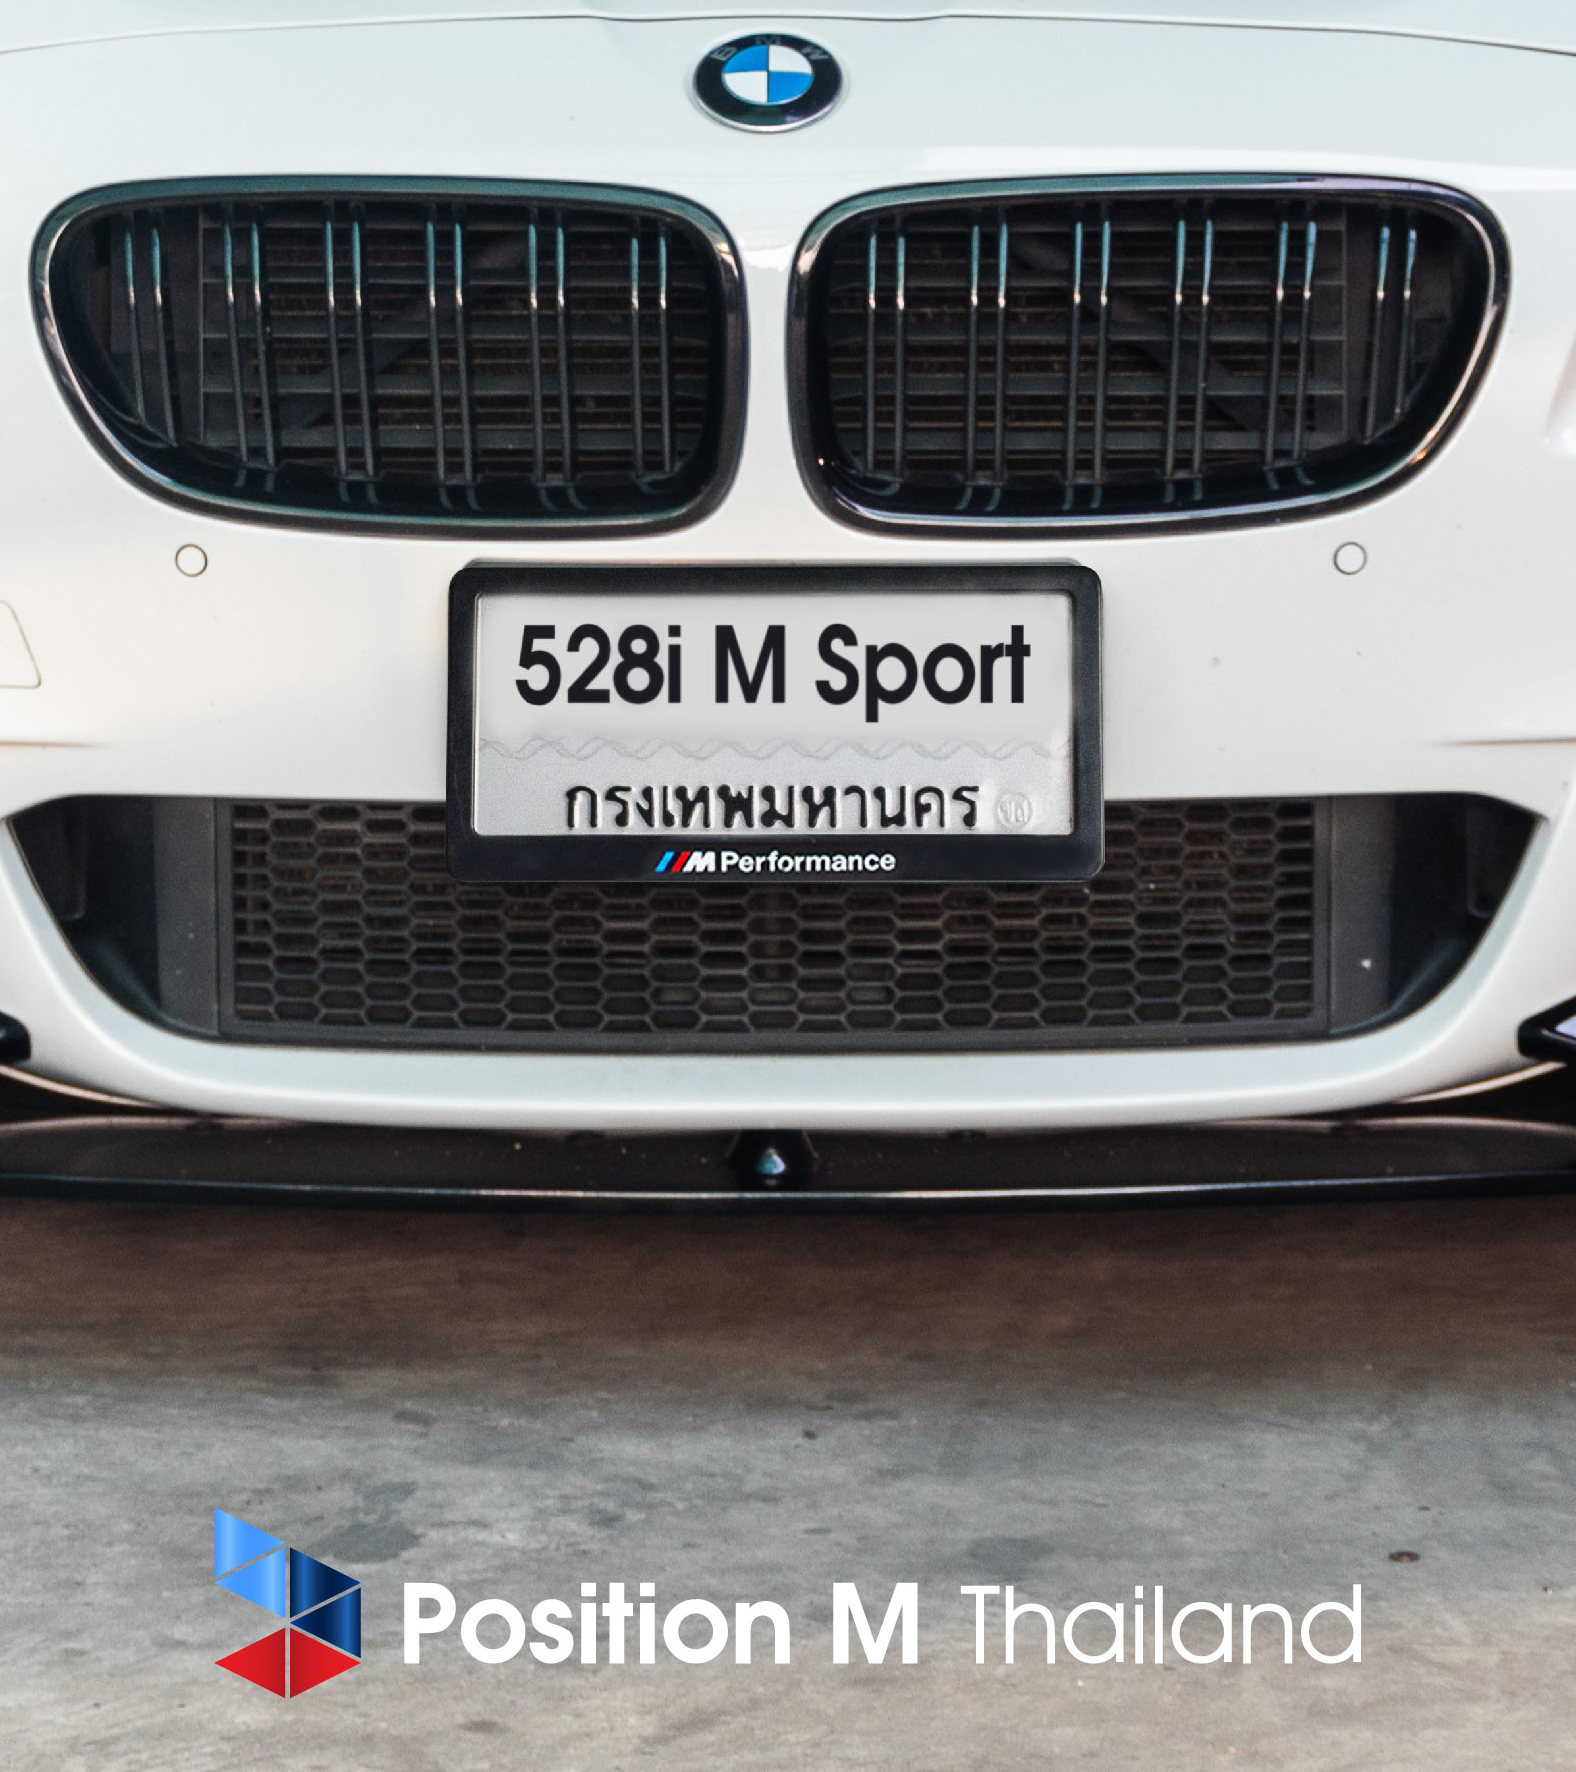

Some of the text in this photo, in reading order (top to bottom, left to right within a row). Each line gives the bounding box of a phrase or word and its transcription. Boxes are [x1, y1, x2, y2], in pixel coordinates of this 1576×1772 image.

[710, 34, 830, 61] BMW
[515, 623, 1031, 723] 528i M Sport
[720, 850, 897, 873] Performance
